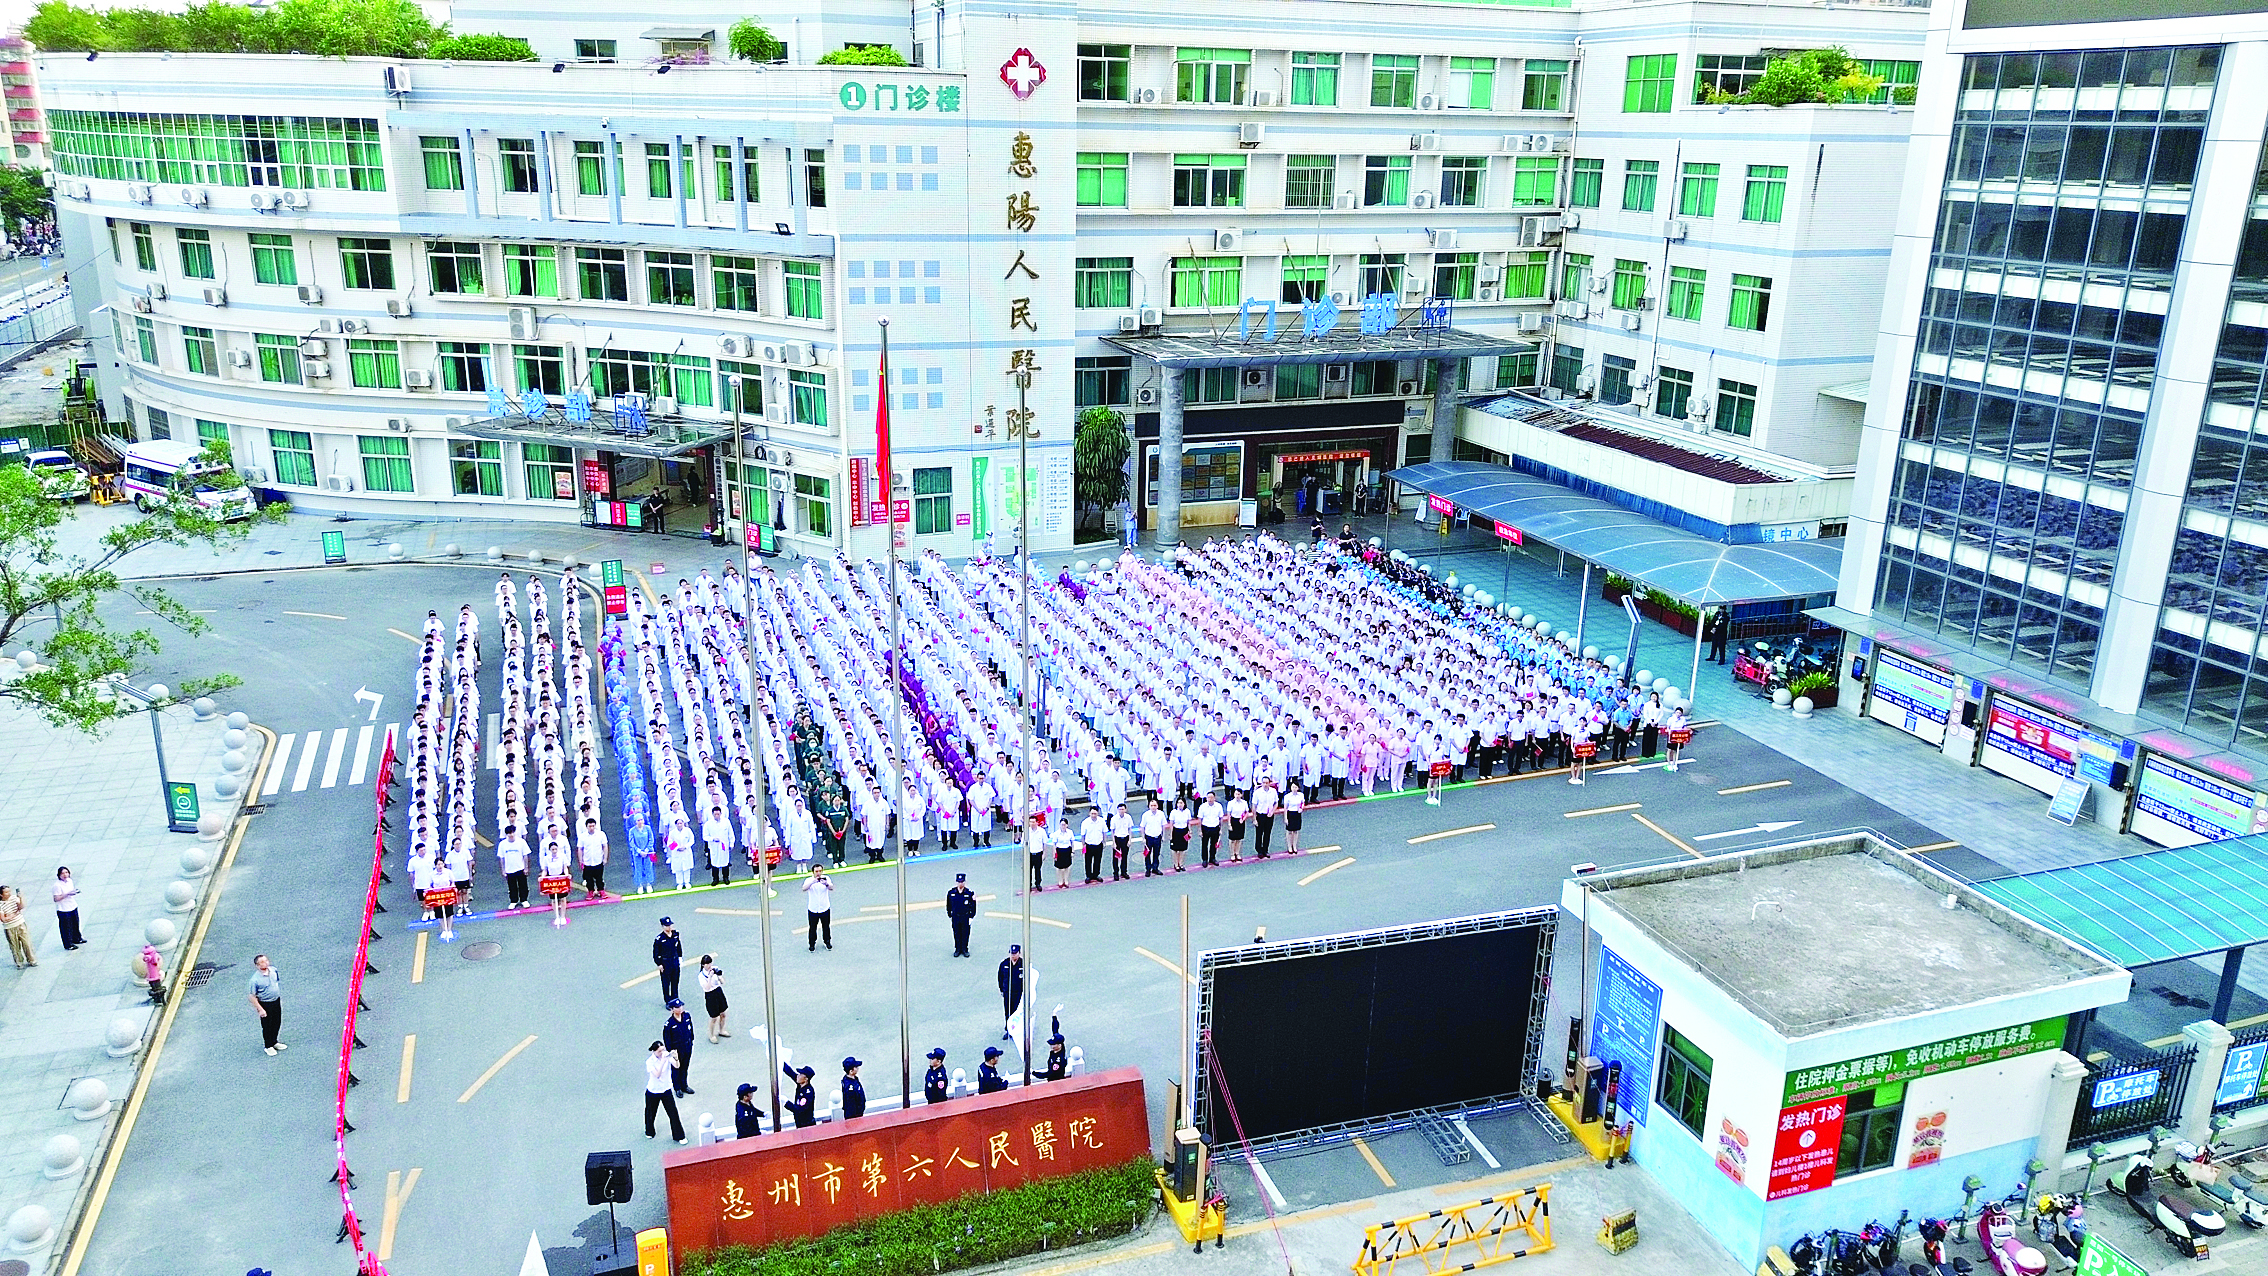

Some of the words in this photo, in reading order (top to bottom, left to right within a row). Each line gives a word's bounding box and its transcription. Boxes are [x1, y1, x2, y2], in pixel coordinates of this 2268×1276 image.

[875, 84, 960, 112] 门诊楼
[1005, 131, 1042, 441] 惠陽人民醫院
[1240, 293, 1398, 341] 门诊部
[2235, 1050, 2252, 1072] P
[2097, 1083, 2116, 1104] P
[2121, 1084, 2153, 1099] 停放处
[2123, 1073, 2155, 1088] 摩托车
[1780, 1103, 1842, 1131] 发热门诊
[721, 1115, 1104, 1221] 惠州市第六人民醫院
[2083, 1247, 2104, 1271] P
